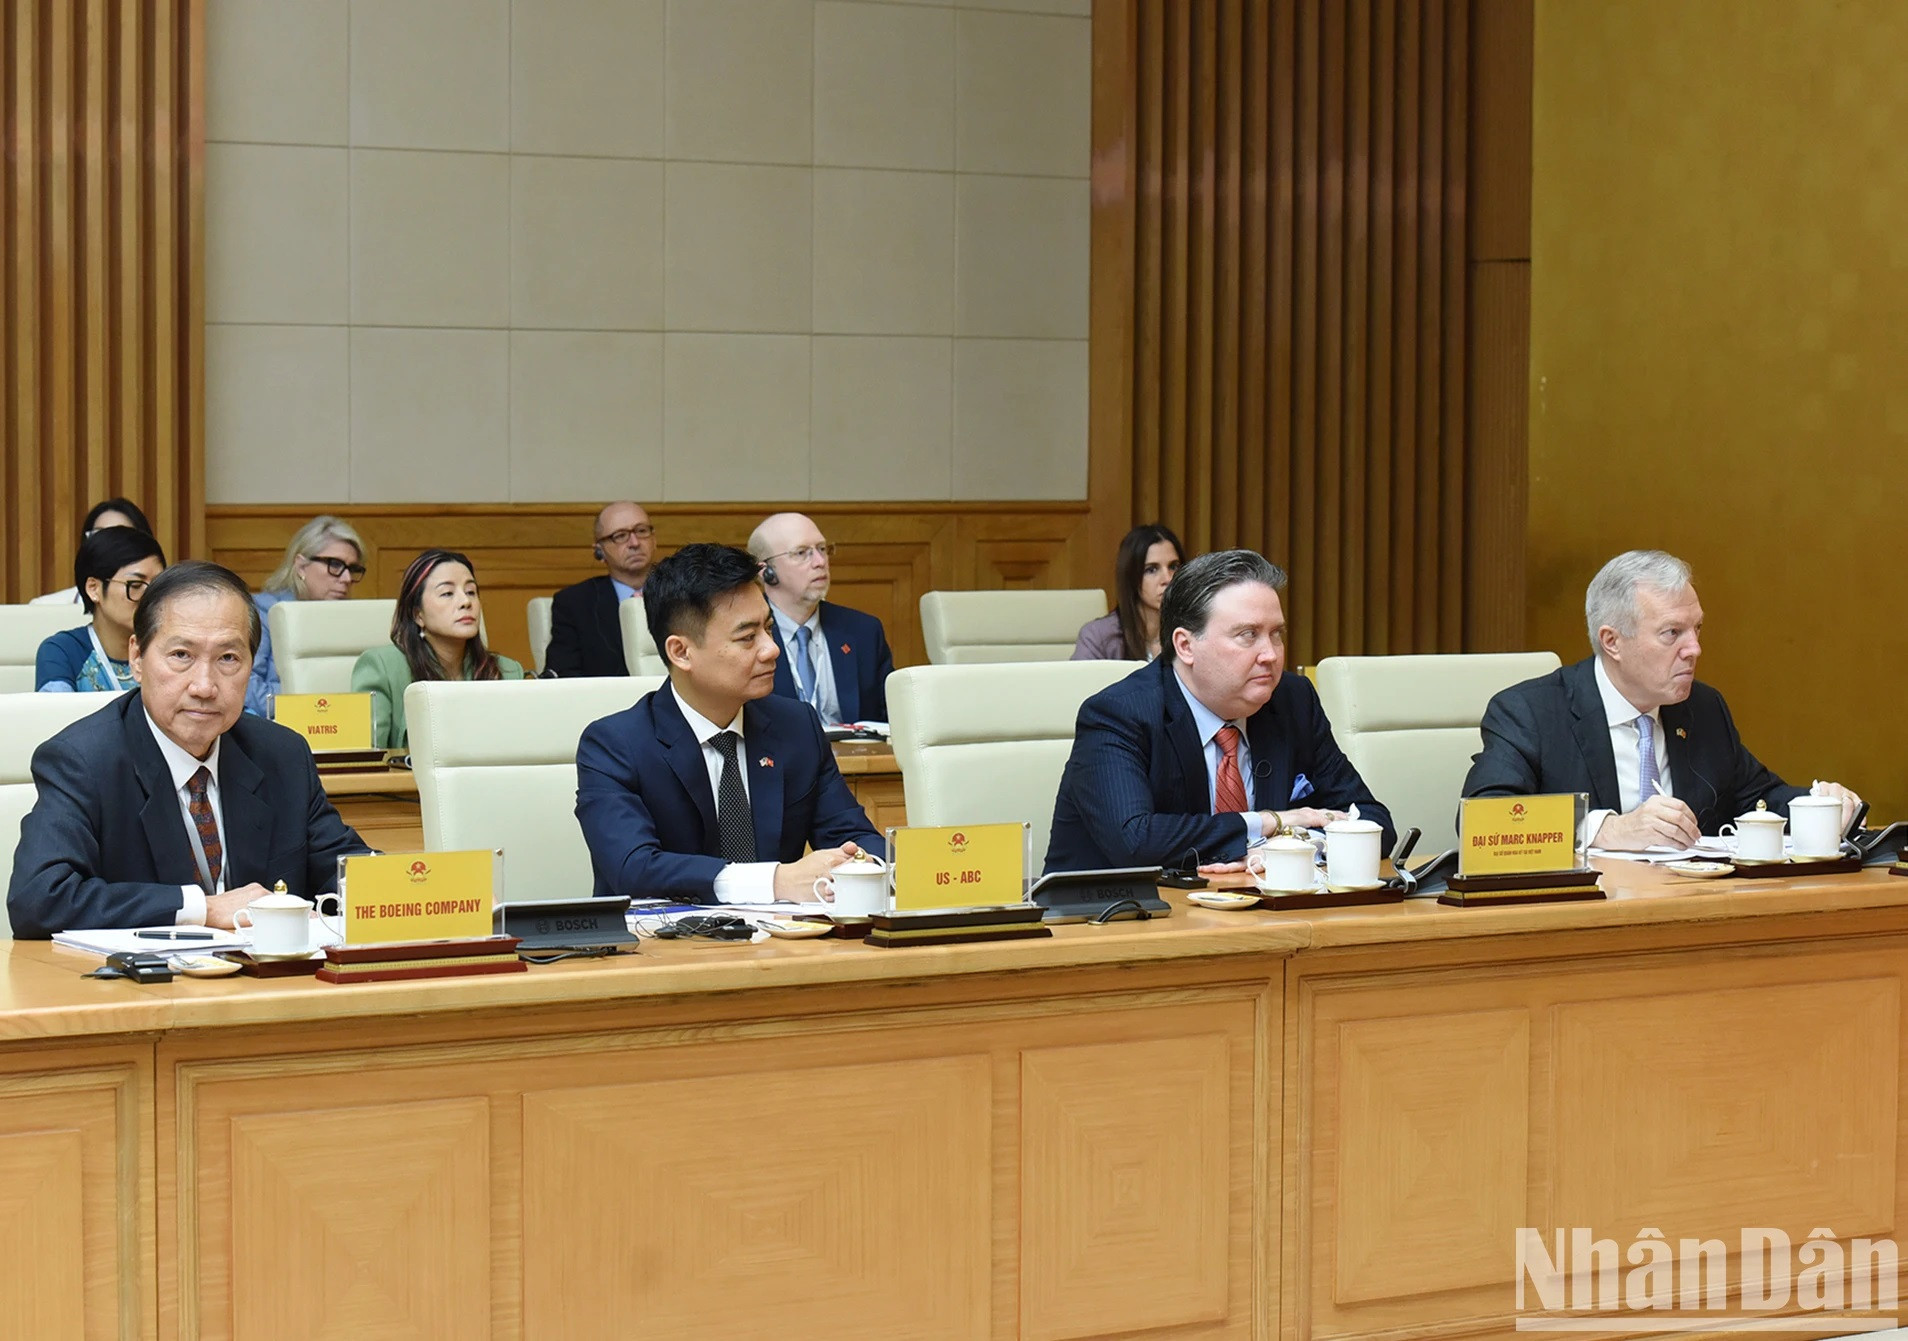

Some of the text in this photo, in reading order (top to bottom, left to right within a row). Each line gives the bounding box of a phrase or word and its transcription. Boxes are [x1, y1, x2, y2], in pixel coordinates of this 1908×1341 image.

[307, 725, 338, 735] VIATRIS
[1472, 836, 1486, 849] ĐẠI
[1501, 834, 1524, 845] MARC
[1526, 832, 1564, 844] KNAPPER
[936, 872, 950, 885] US
[960, 870, 981, 884] ABC
[1097, 888, 1134, 900] BOSCH
[355, 898, 482, 920] THE BOEING COMPANY
[555, 918, 599, 931] BOSCH
